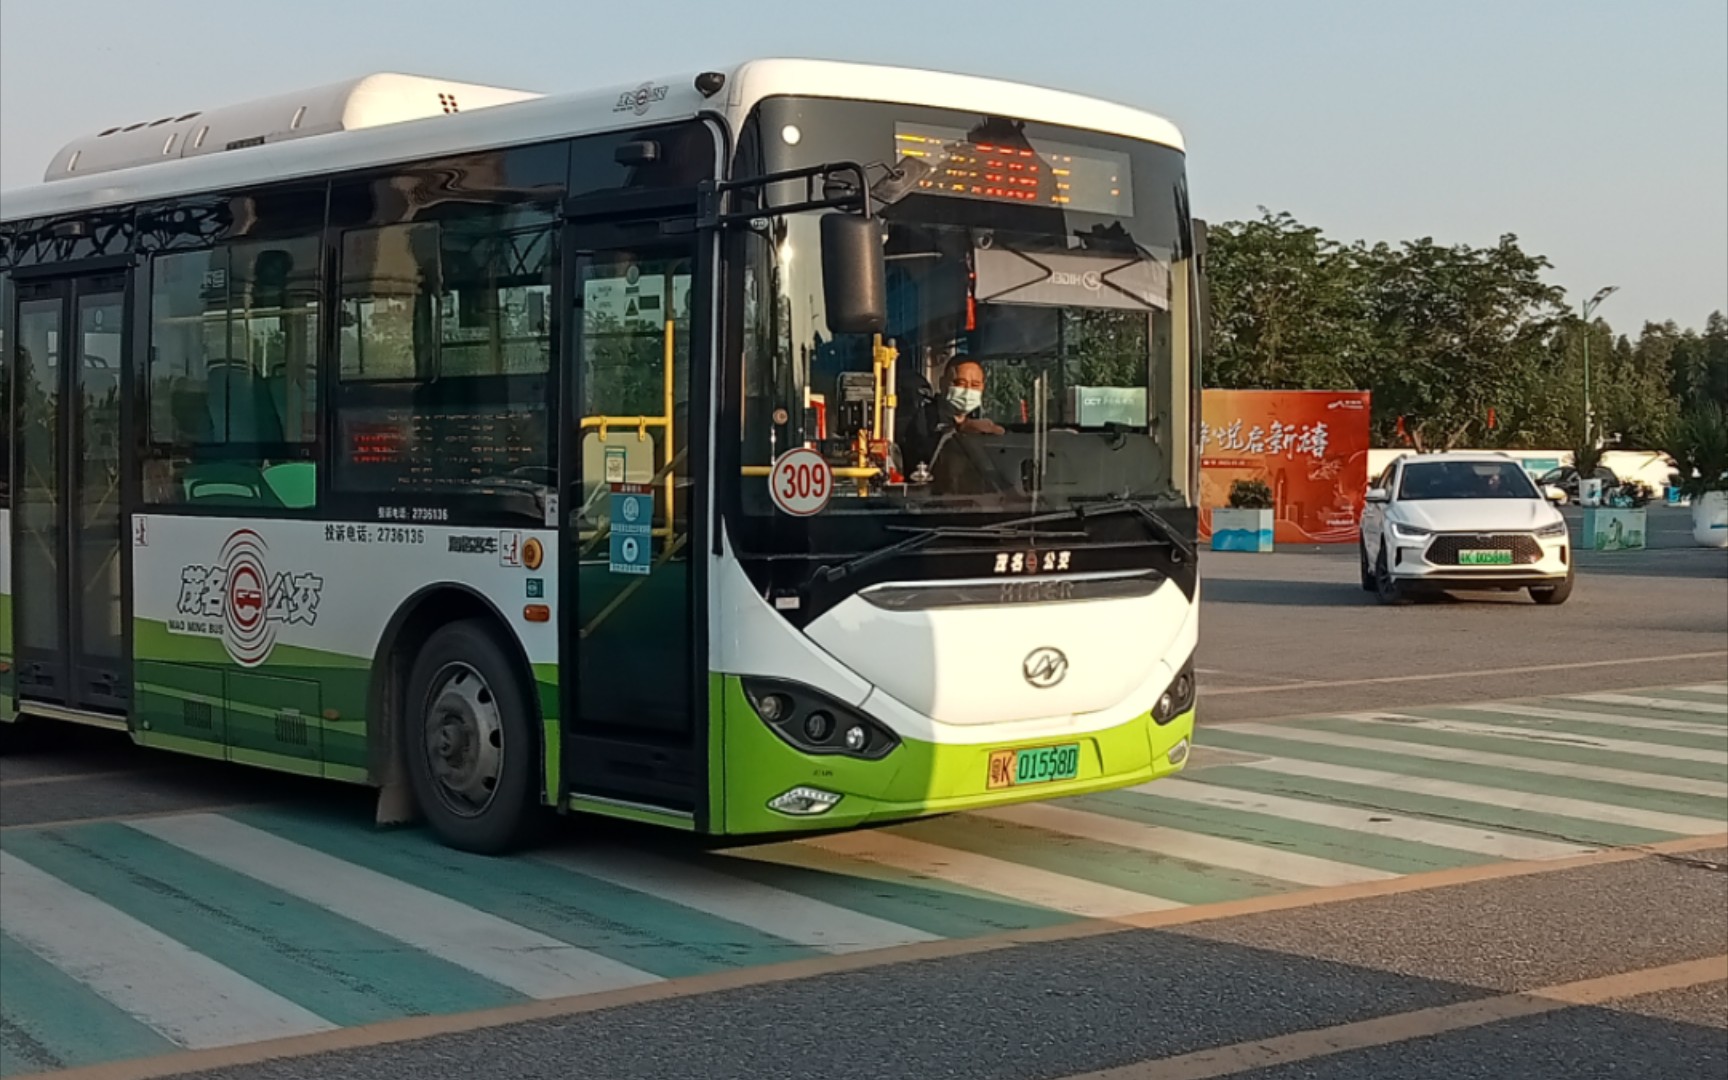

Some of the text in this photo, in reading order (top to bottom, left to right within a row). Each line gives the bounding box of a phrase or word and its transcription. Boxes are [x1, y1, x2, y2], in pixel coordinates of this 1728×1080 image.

[783, 463, 825, 498] 309
[187, 621, 207, 633] MING
[209, 623, 224, 635] BUS
[1018, 748, 1076, 780] 01558D
